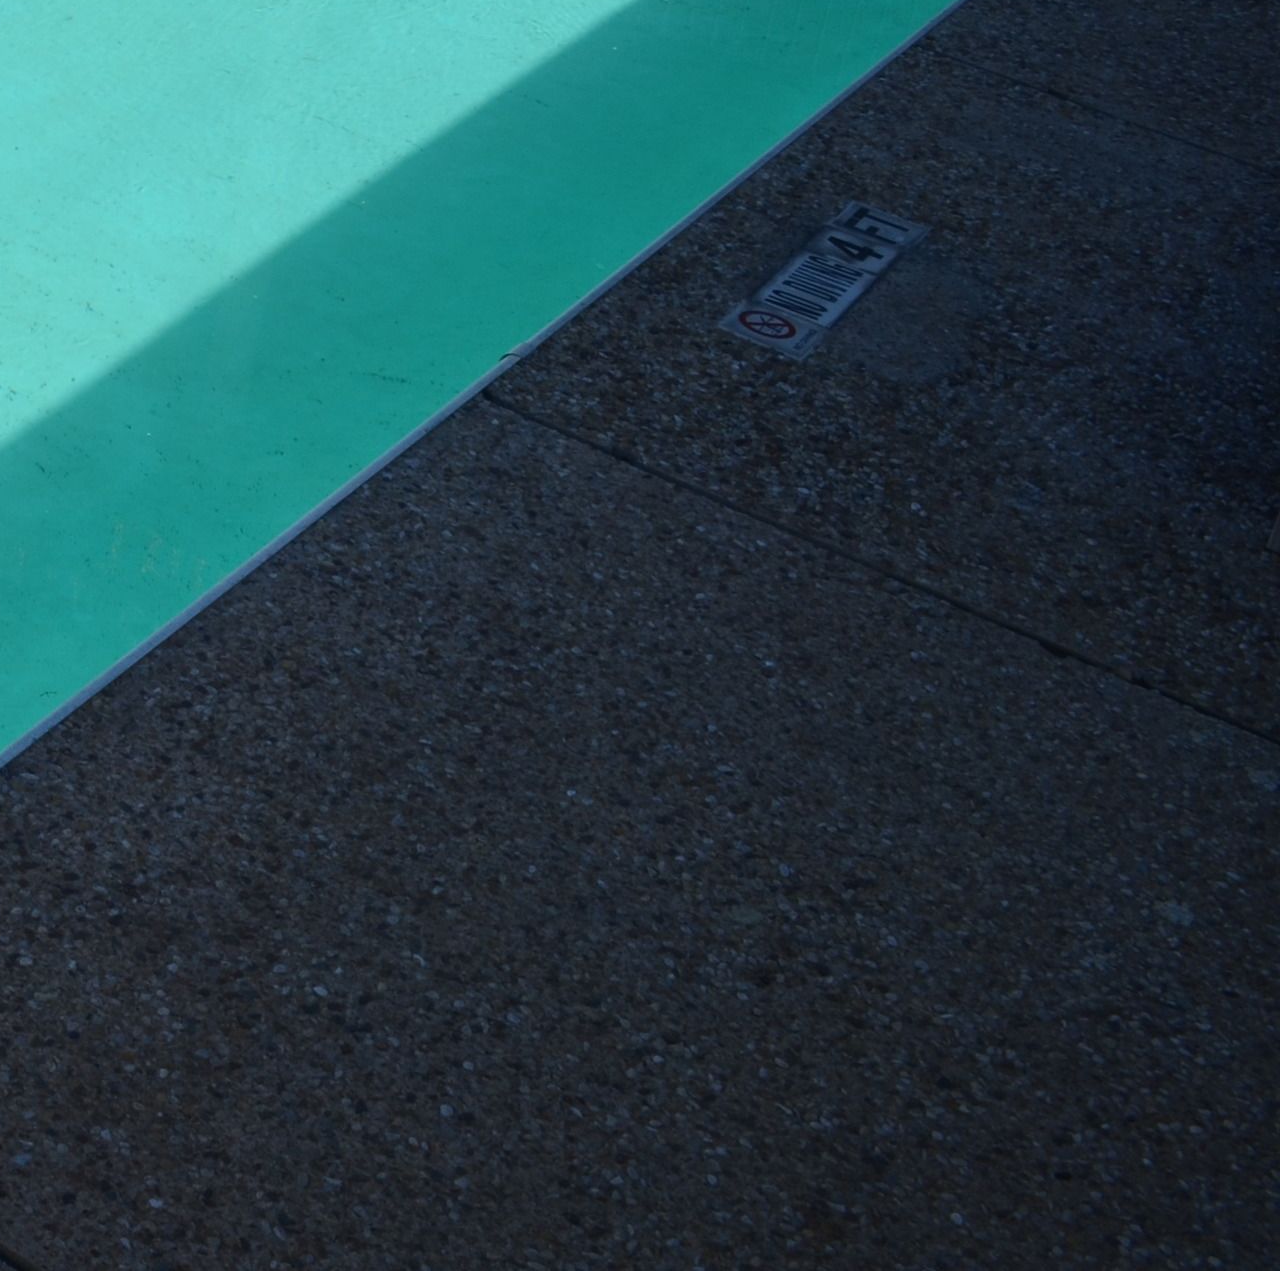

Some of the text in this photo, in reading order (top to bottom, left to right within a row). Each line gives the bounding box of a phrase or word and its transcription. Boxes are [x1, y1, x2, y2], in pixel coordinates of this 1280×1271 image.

[764, 207, 910, 321] NO DIVING 4 FT
